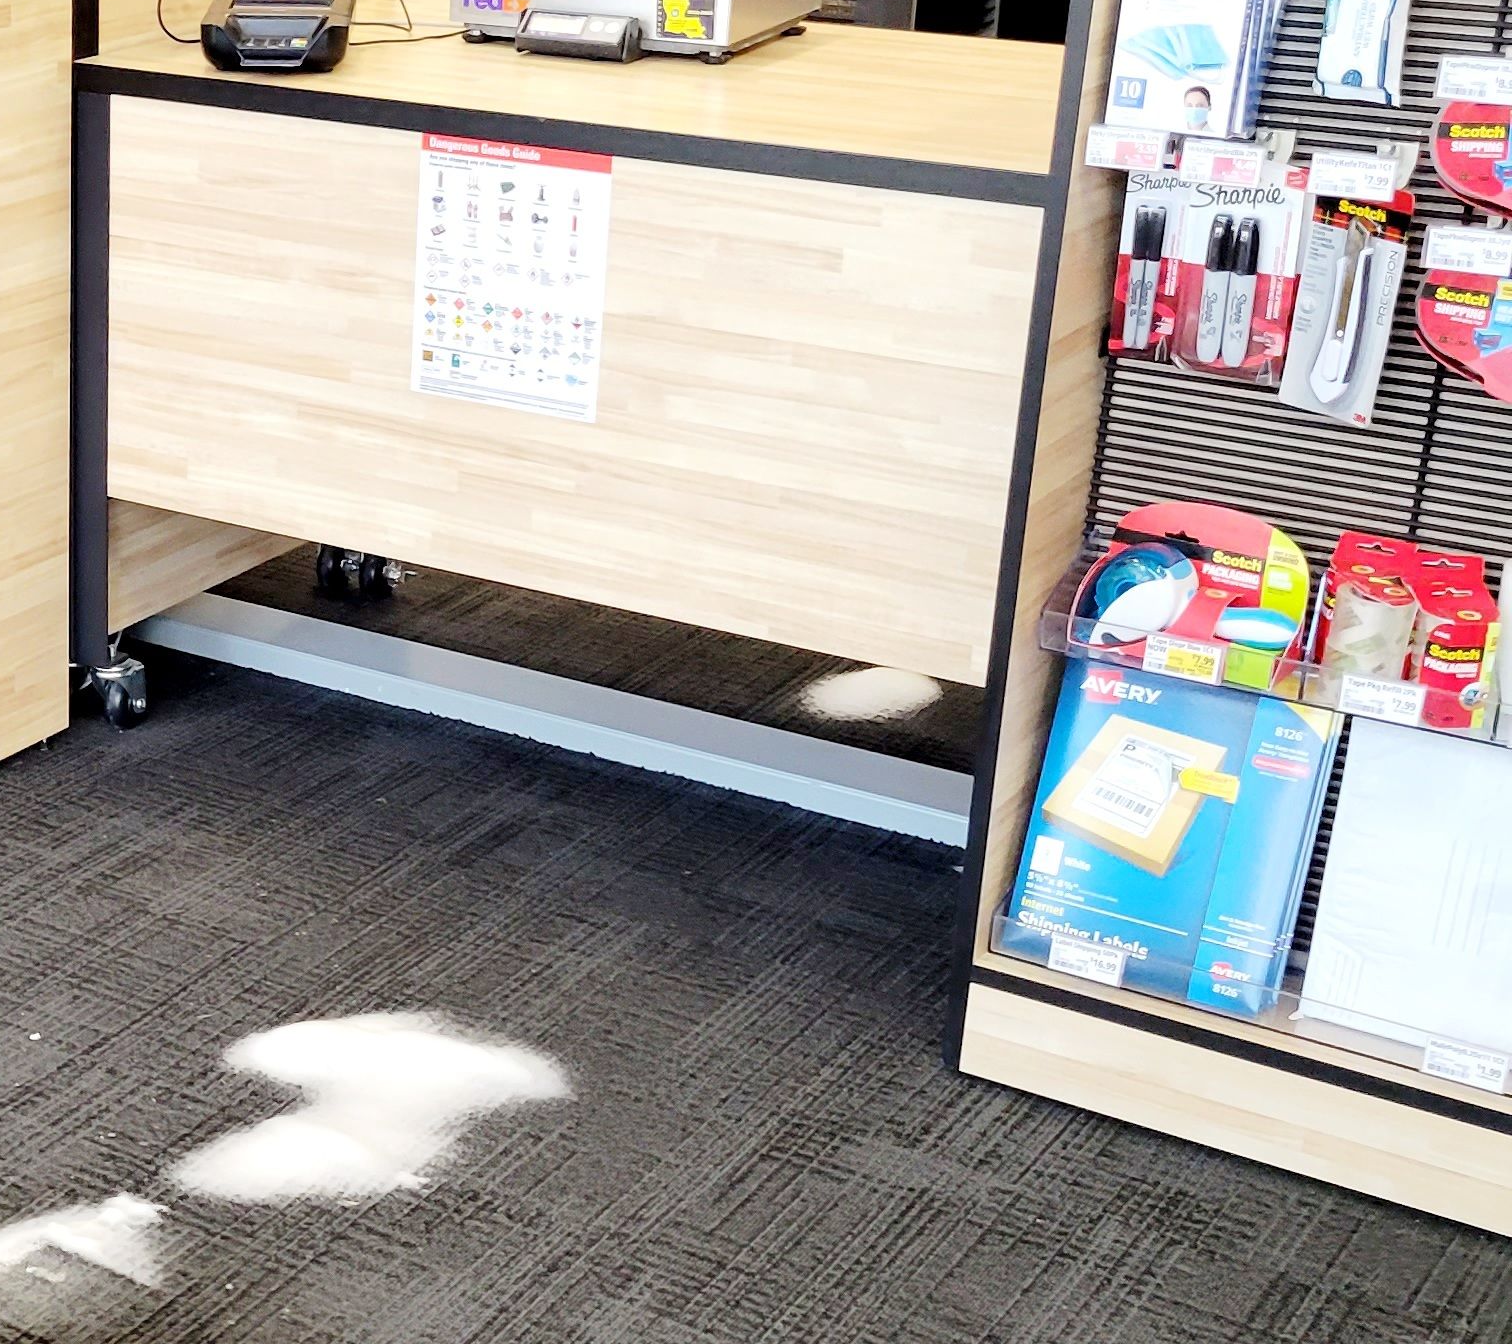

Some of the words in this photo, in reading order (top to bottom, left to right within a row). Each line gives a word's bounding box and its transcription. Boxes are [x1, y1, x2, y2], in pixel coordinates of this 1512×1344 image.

[1119, 80, 1140, 99] 10
[1449, 125, 1506, 139] Scotch
[429, 136, 479, 154] Dangerous
[480, 143, 511, 158] Goods
[512, 146, 541, 162] Guide
[1450, 140, 1505, 154] SHIPPING
[1189, 183, 1286, 210] Sharpie
[1338, 199, 1387, 223] Scotch
[1376, 249, 1398, 327] PRECISION
[1434, 286, 1490, 308] Scotch
[1434, 302, 1487, 321] SHIPPING
[1352, 413, 1367, 425] 3M
[1212, 549, 1262, 573] Scotch
[1201, 563, 1261, 584] PACKAGING
[1147, 643, 1168, 654] NOW
[1429, 642, 1481, 661] Scotch
[1079, 673, 1163, 705] AVERY
[1348, 677, 1366, 690] Tape
[1366, 681, 1381, 693] Pkg
[1273, 725, 1303, 742] 8126
[1063, 855, 1092, 872] White
[1020, 895, 1065, 917] Internet
[1209, 964, 1252, 982] AVERY
[1212, 983, 1239, 998] 8126
